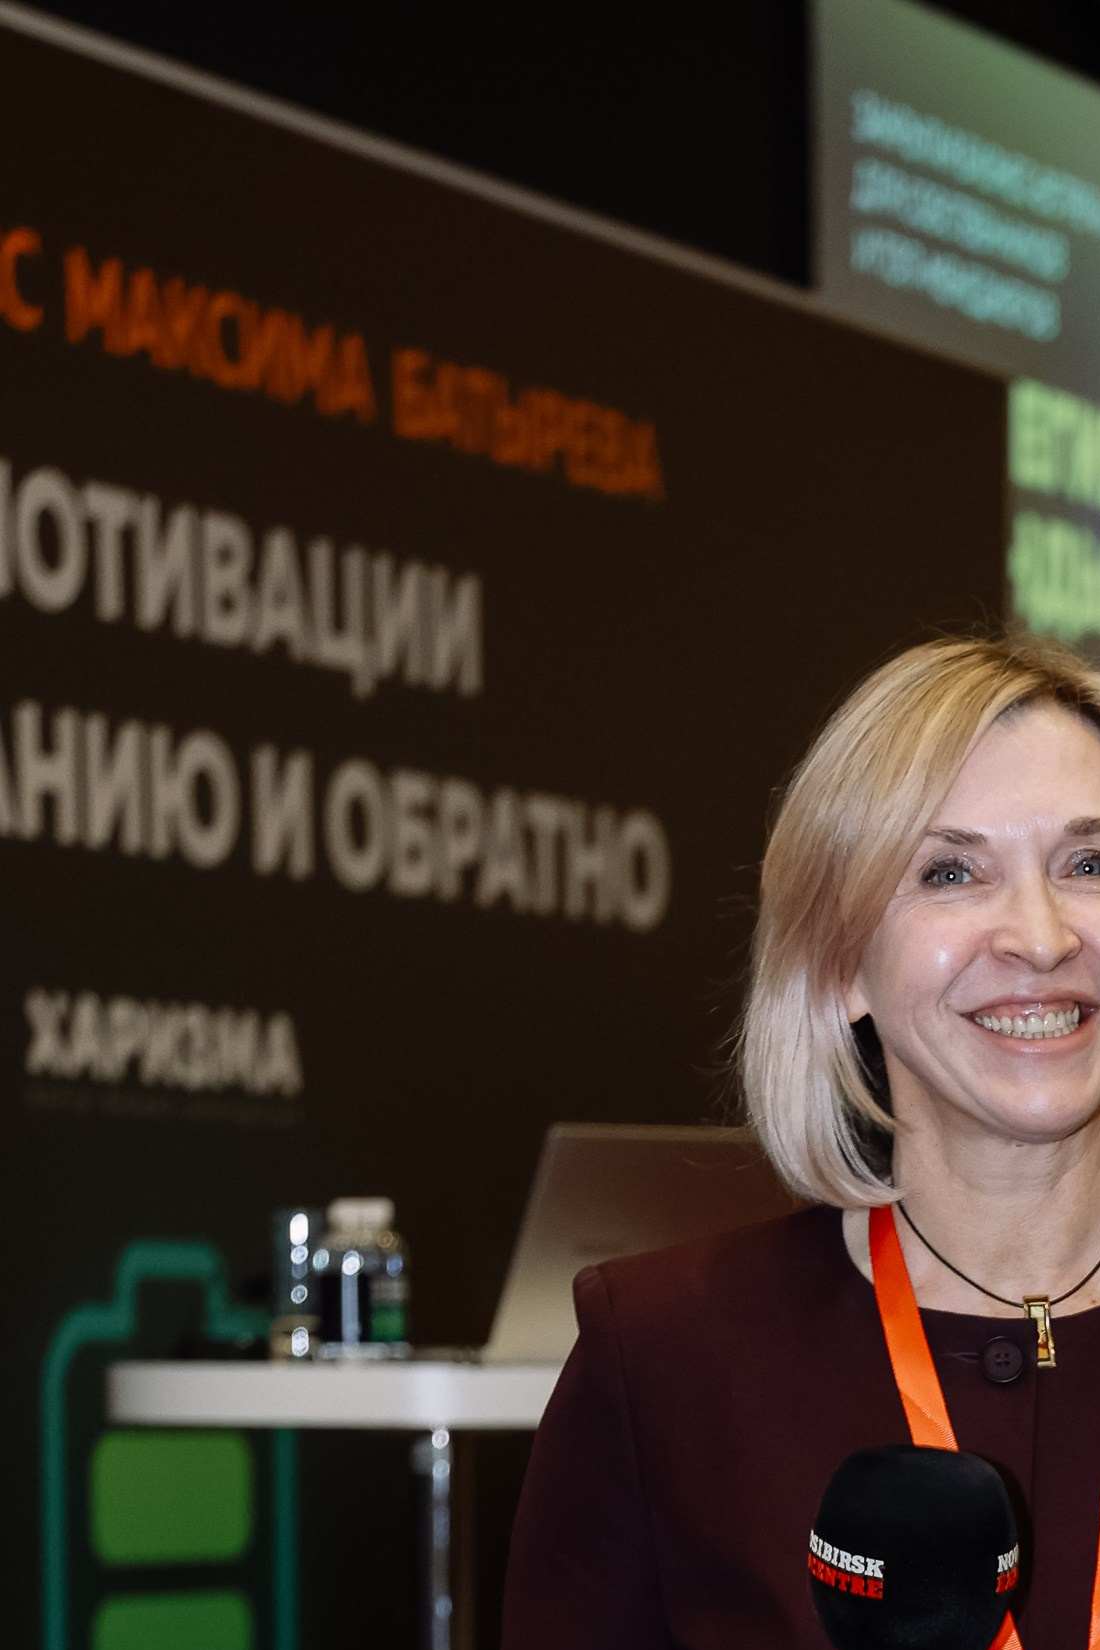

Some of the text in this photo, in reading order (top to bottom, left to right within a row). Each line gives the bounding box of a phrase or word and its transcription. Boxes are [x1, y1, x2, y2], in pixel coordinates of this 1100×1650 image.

[65, 246, 378, 424] МАКСИМА
[0, 456, 484, 699] ОТИВАЦИИ
[0, 700, 671, 932] НИЮ И ОБРАТНО
[25, 987, 303, 1096] ХАРИЗМА
